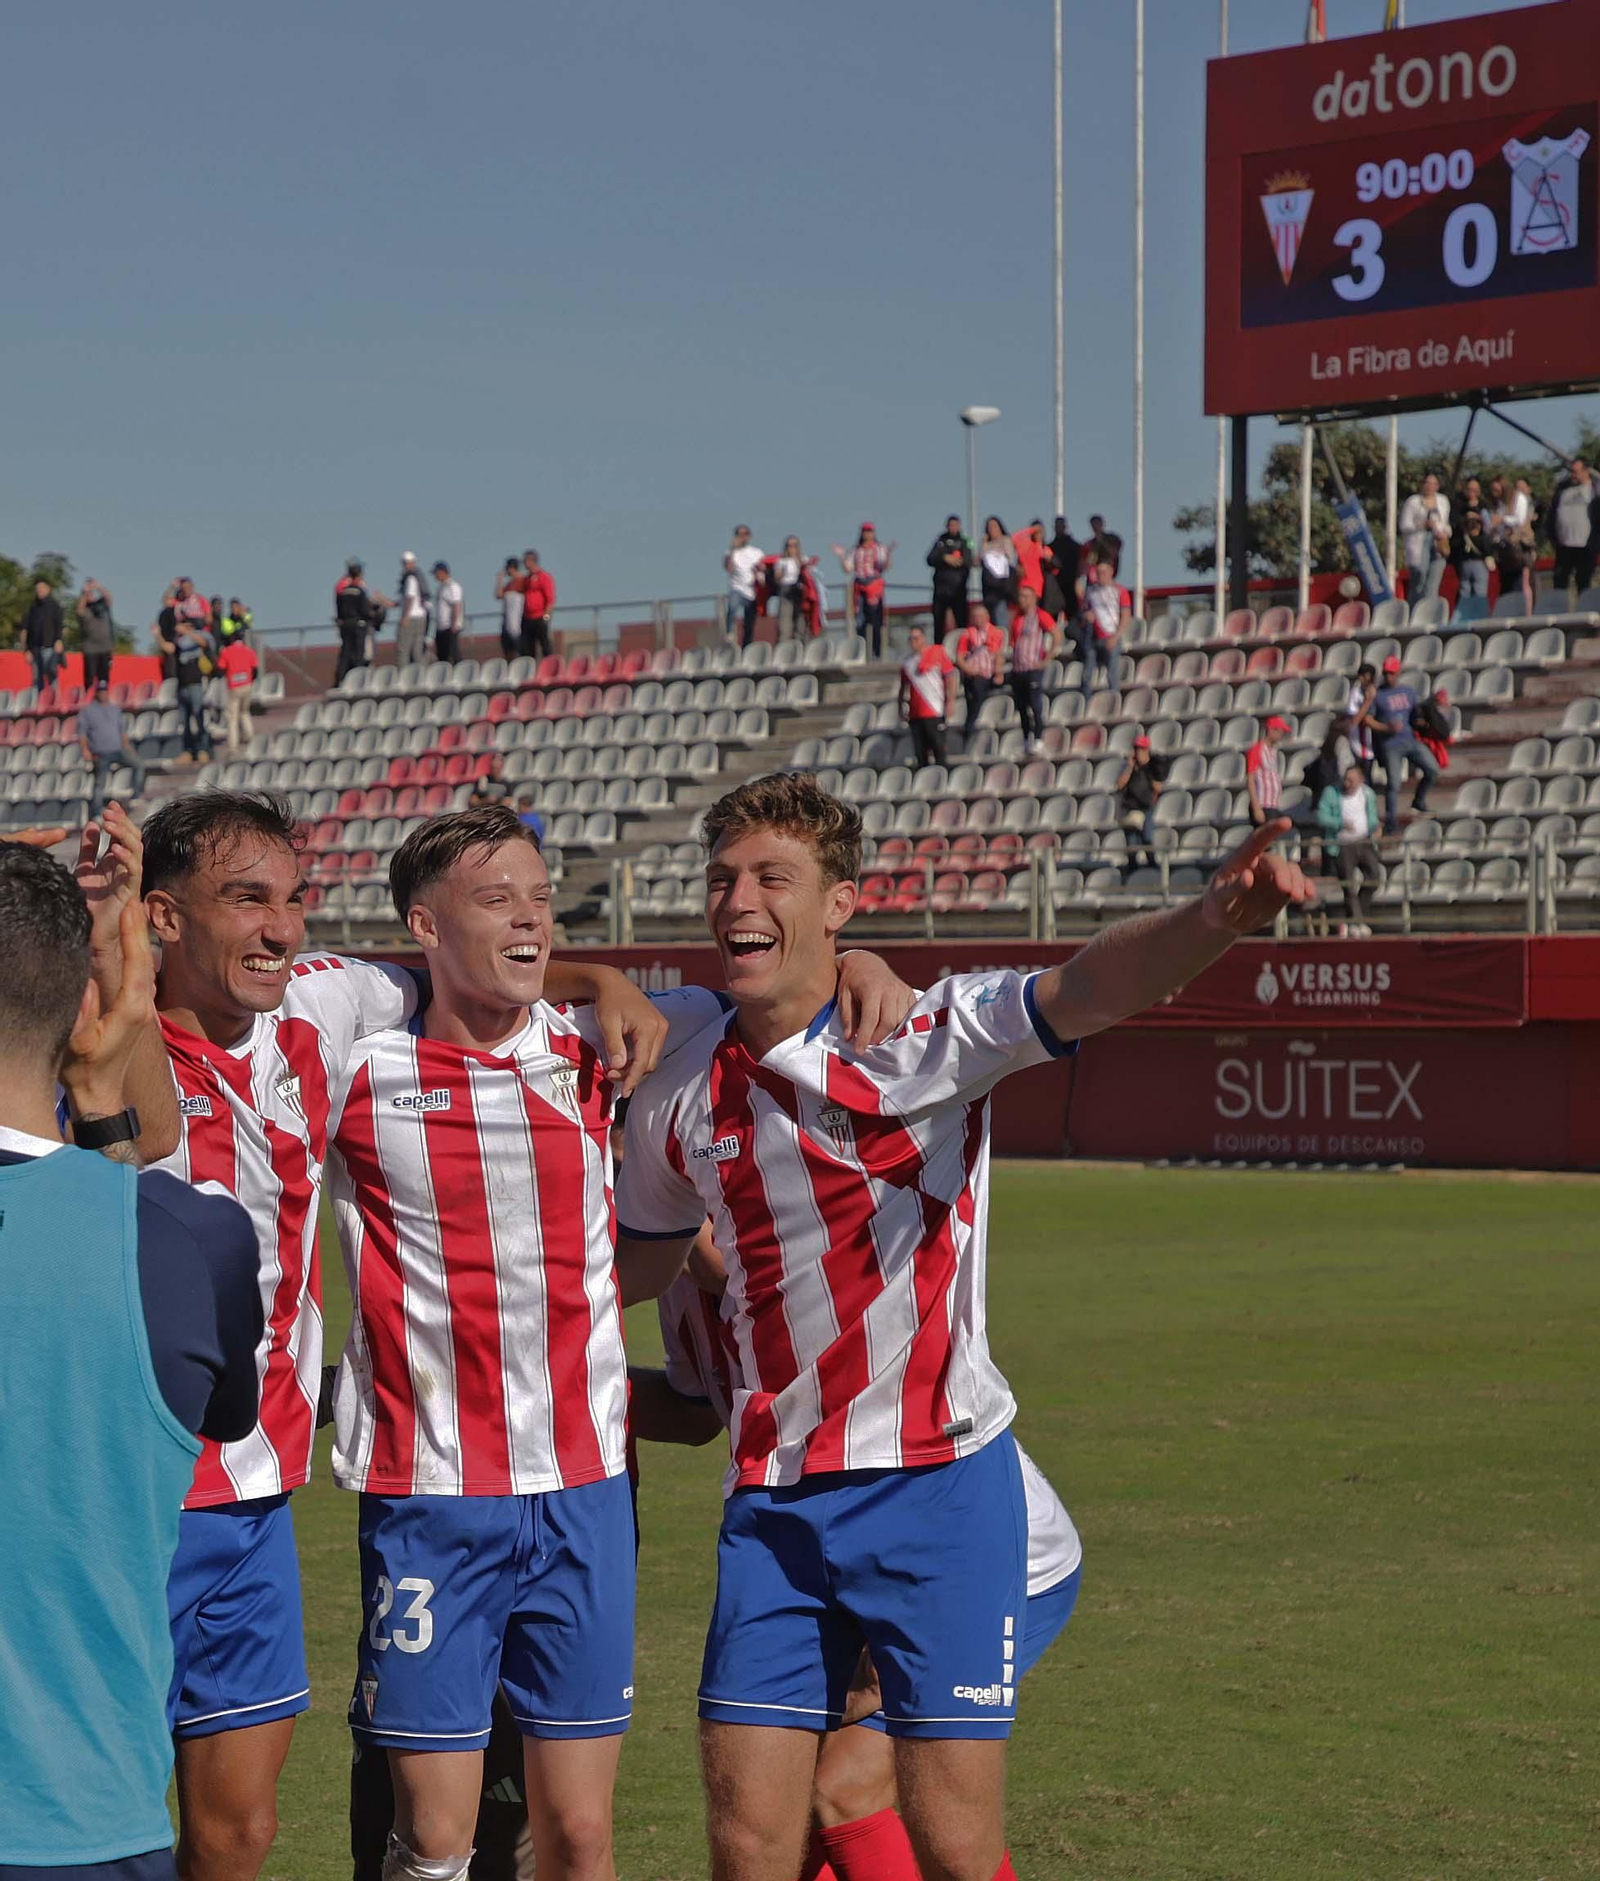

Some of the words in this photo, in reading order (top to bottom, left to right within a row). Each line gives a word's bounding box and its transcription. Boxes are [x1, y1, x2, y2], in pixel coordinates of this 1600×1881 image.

[1312, 44, 1517, 123] datono
[1355, 148, 1475, 203] 90:00
[1331, 217, 1386, 301] 3
[1442, 202, 1498, 288] 0
[1310, 351, 1342, 380] La
[1347, 345, 1412, 375] Fibra
[1417, 338, 1450, 368] de
[1453, 328, 1516, 368] Aquí
[1279, 962, 1391, 991] VERSUS
[1292, 991, 1381, 1006] E-LEARNING
[179, 1096, 210, 1109] pelli
[393, 1090, 449, 1109] capelli
[692, 1137, 737, 1160] capelli
[1214, 1133, 1292, 1153] EQUIPOS
[1298, 1134, 1320, 1153] DE
[1328, 1134, 1426, 1155] DESCANSO
[368, 1574, 436, 1654] 23
[953, 1684, 1002, 1703] capelli
